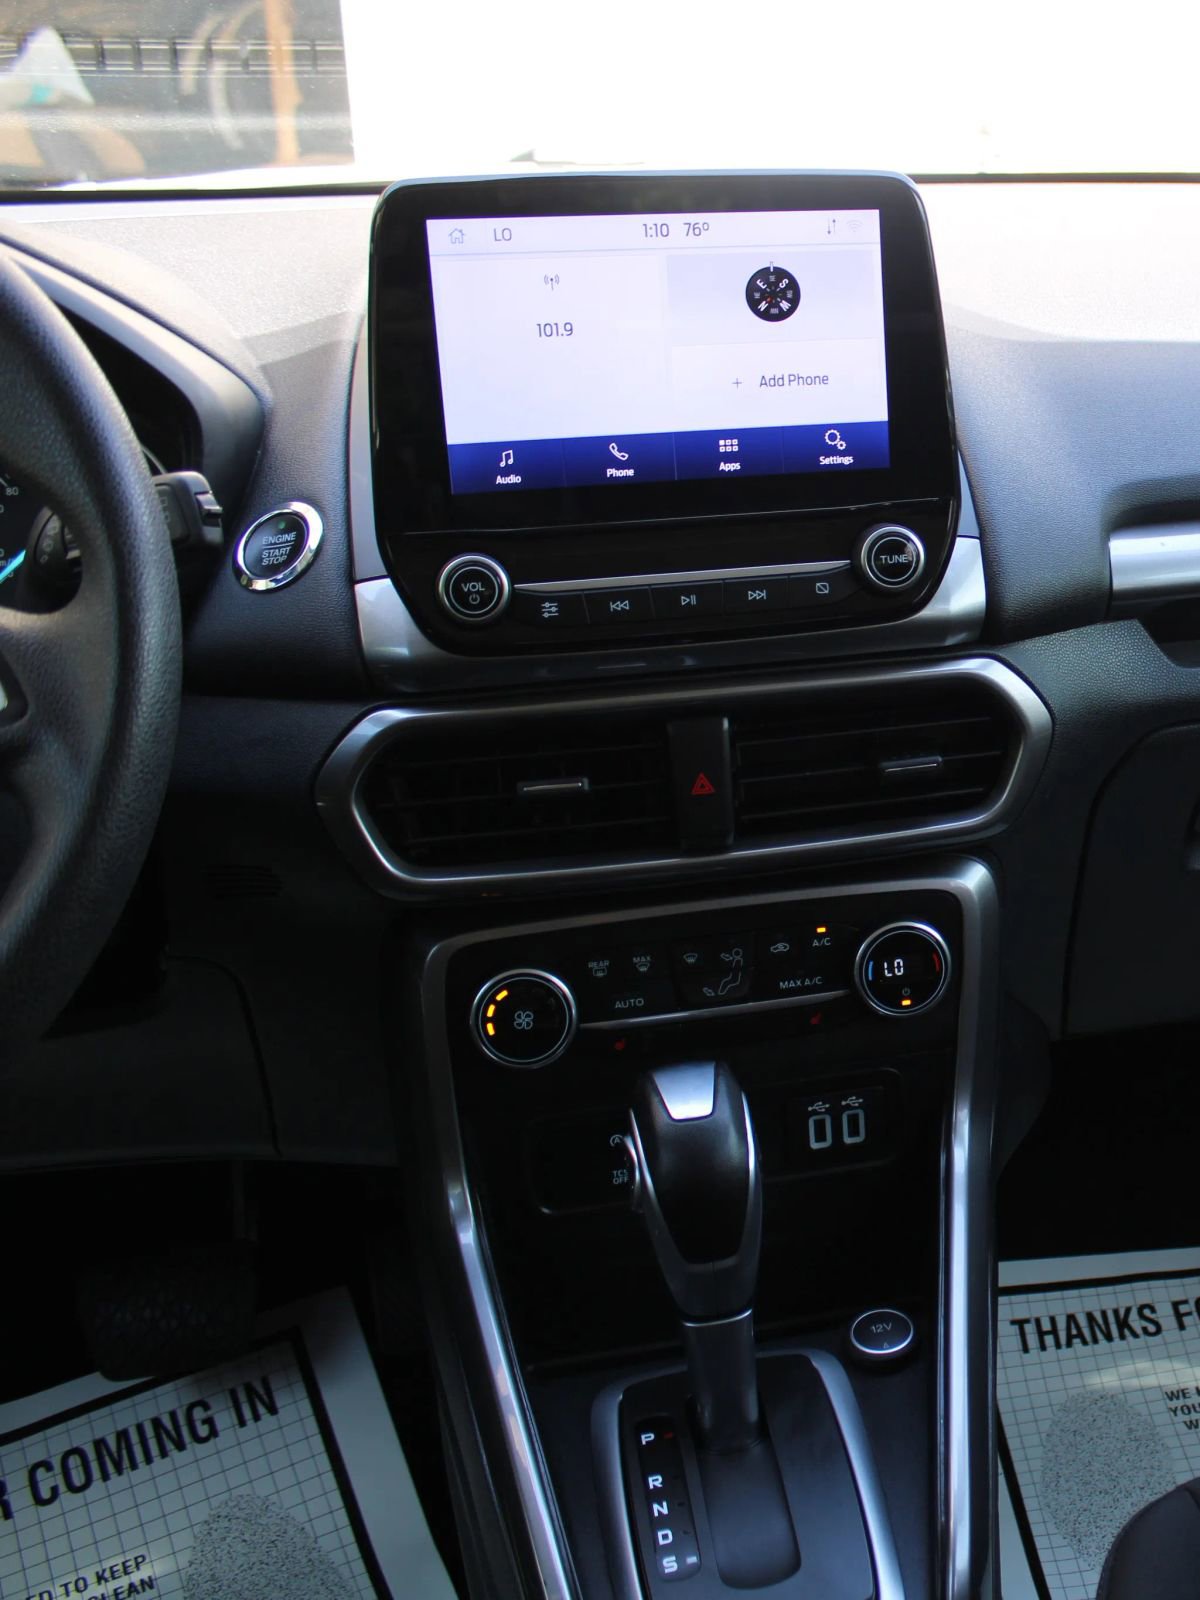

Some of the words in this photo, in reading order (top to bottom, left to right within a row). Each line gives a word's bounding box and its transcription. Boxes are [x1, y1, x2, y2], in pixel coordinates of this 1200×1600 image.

[493, 228, 513, 242] LO
[642, 222, 670, 238] 1:10
[779, 278, 789, 288] S
[536, 322, 574, 338] 101.9
[759, 374, 784, 388] Add
[786, 372, 830, 387] Phone
[719, 460, 741, 473] Apps
[819, 453, 854, 467] Settings
[495, 473, 522, 485] Audio
[606, 466, 635, 479] Phone
[6, 486, 19, 496] 80
[262, 532, 297, 545] ENGINE
[262, 547, 291, 559] START
[880, 554, 909, 564] TUNE
[262, 554, 287, 566] STOP
[461, 582, 486, 593] VOL
[812, 938, 832, 947] A/C
[588, 960, 610, 969] REAR
[633, 955, 652, 963] MAX
[779, 978, 802, 990] MAX
[804, 976, 823, 986] A/C
[614, 998, 645, 1009] AUTO
[613, 1177, 628, 1185] OFF
[871, 1322, 893, 1334] 12V
[1010, 1304, 1162, 1355] THANKS
[1165, 1388, 1192, 1402] WE
[27, 1397, 220, 1507] COMING
[227, 1375, 280, 1429] IN
[640, 1433, 655, 1445] P
[648, 1475, 663, 1489] R
[652, 1501, 669, 1517] N
[657, 1530, 674, 1544] D
[662, 1556, 678, 1574] S
[59, 1576, 89, 1597] TO
[95, 1554, 147, 1586] KEEP
[88, 1575, 156, 1600] EAN
